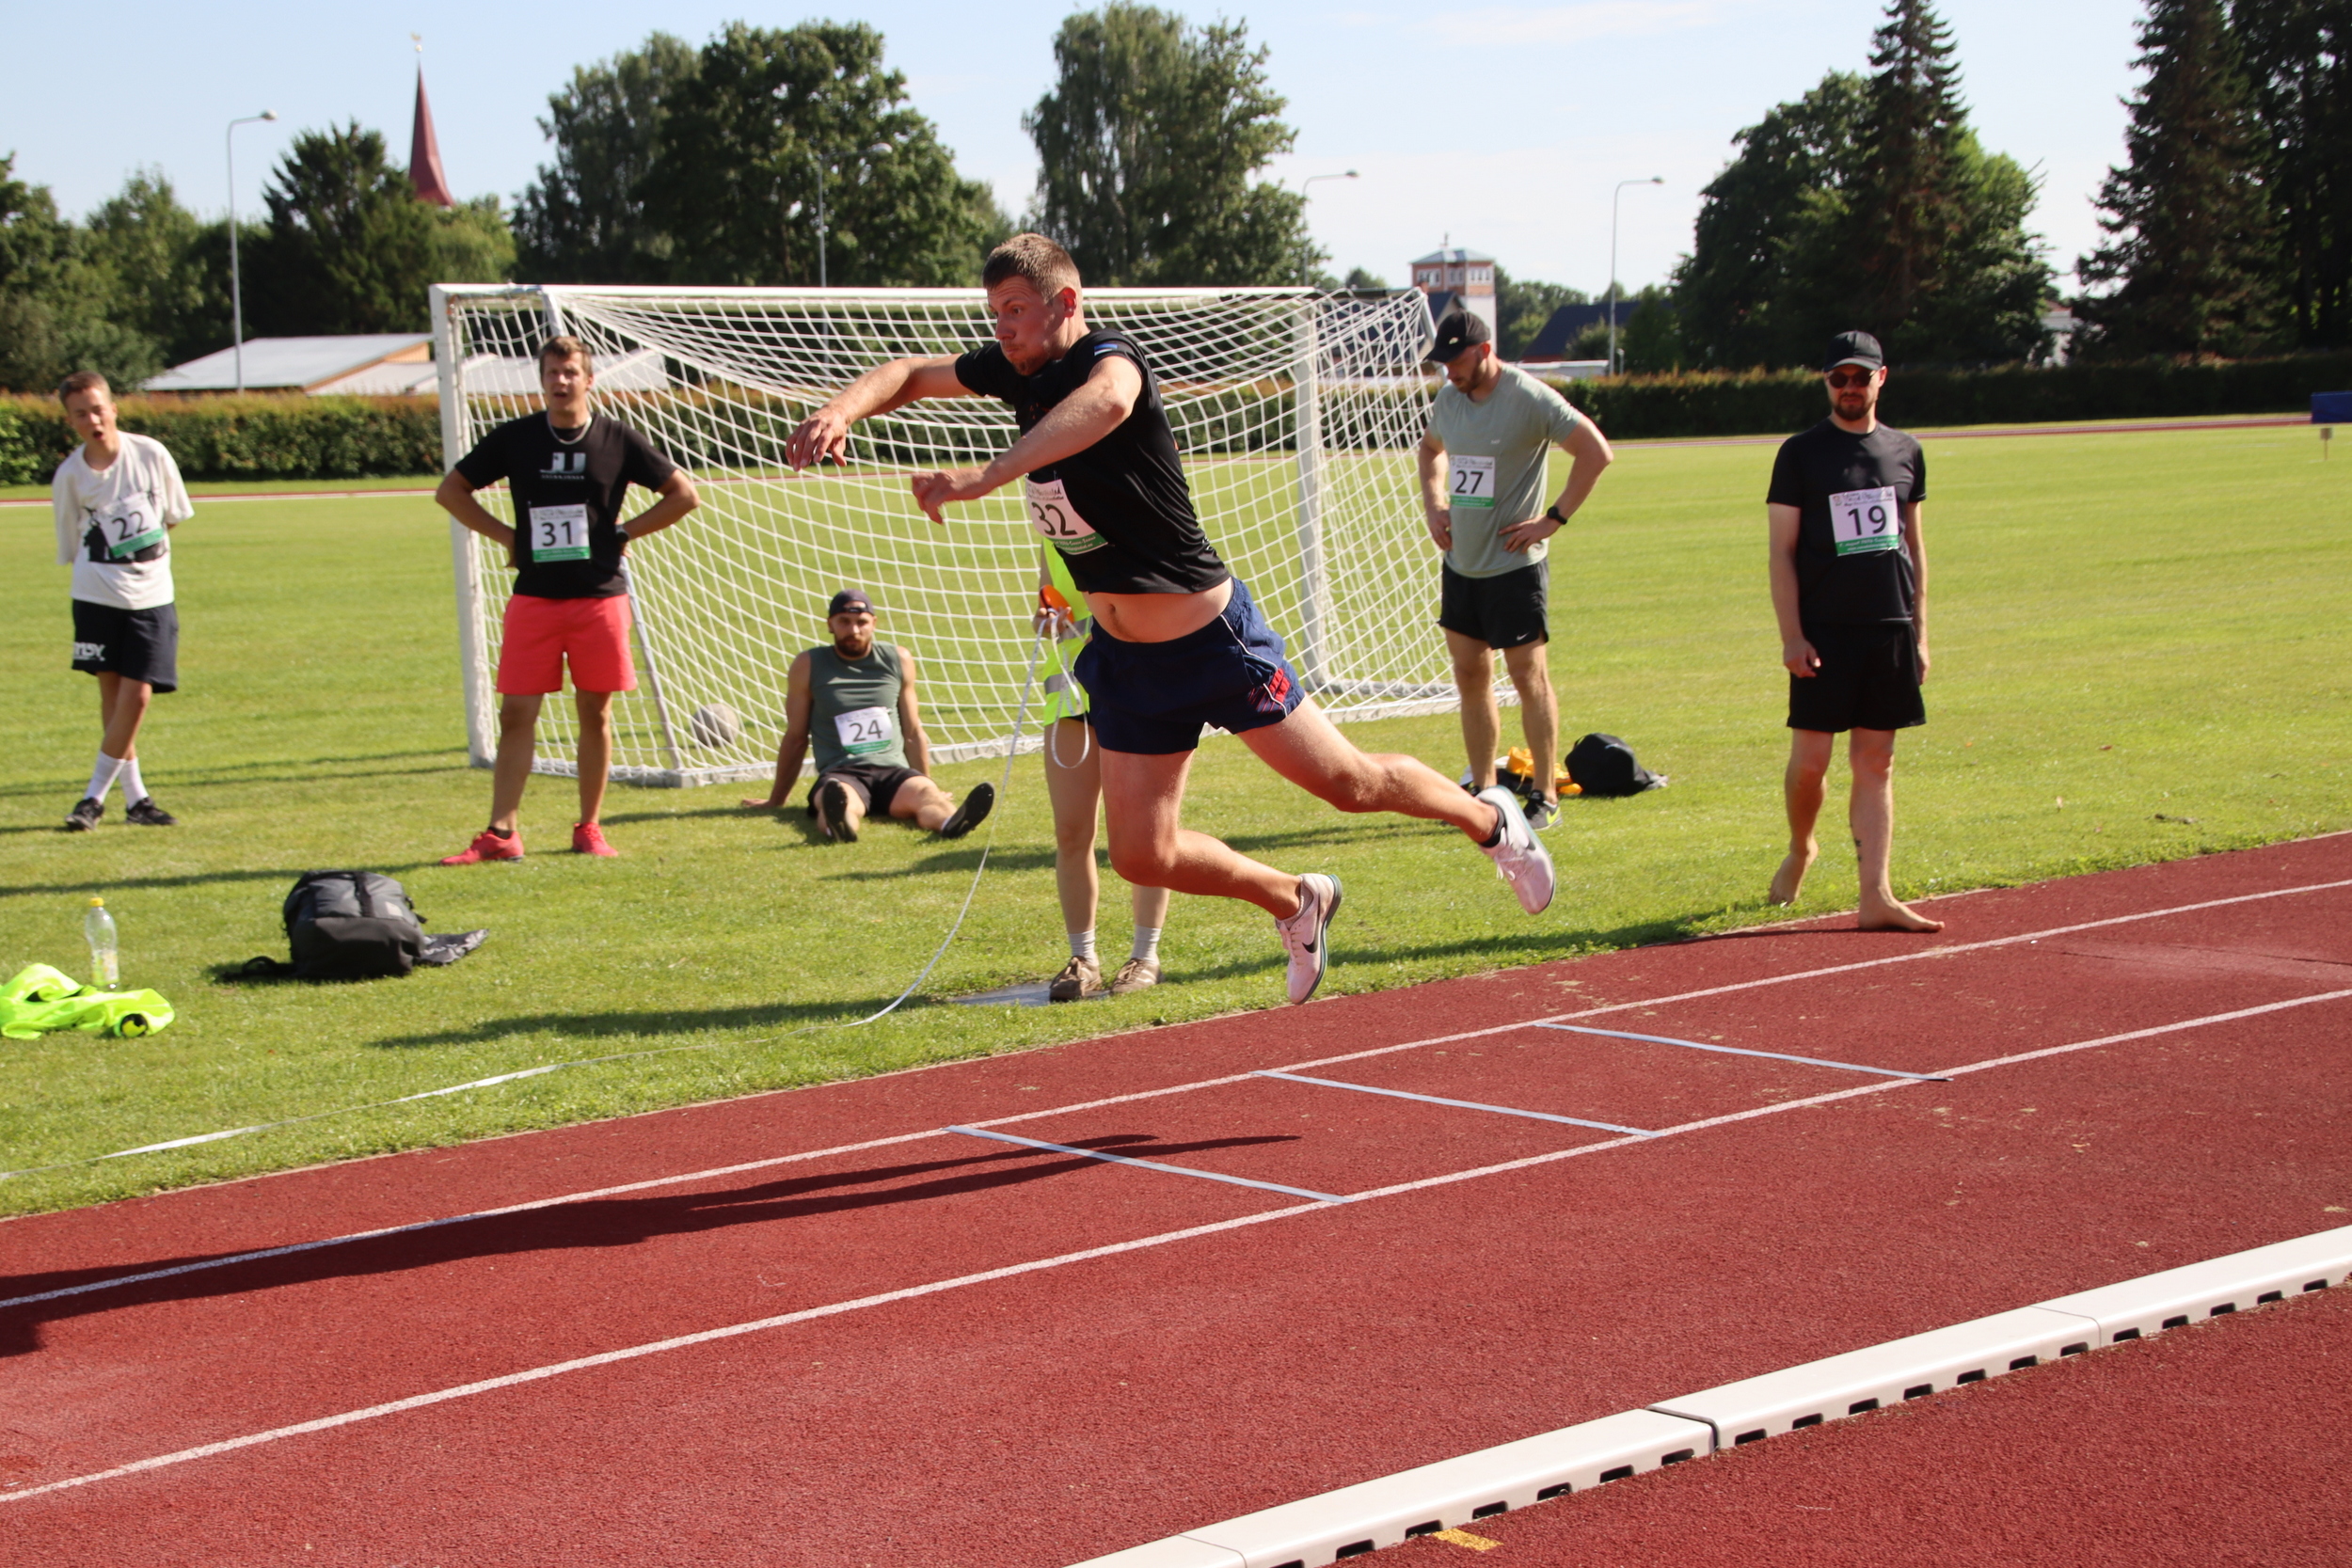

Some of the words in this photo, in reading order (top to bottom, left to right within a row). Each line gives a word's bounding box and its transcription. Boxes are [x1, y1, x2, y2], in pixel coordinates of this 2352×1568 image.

[1454, 469, 1485, 495] 27
[111, 511, 151, 542] 22
[1031, 501, 1078, 536] 32
[1847, 505, 1887, 536] 19
[541, 520, 573, 546] 31
[849, 720, 883, 743] 24
